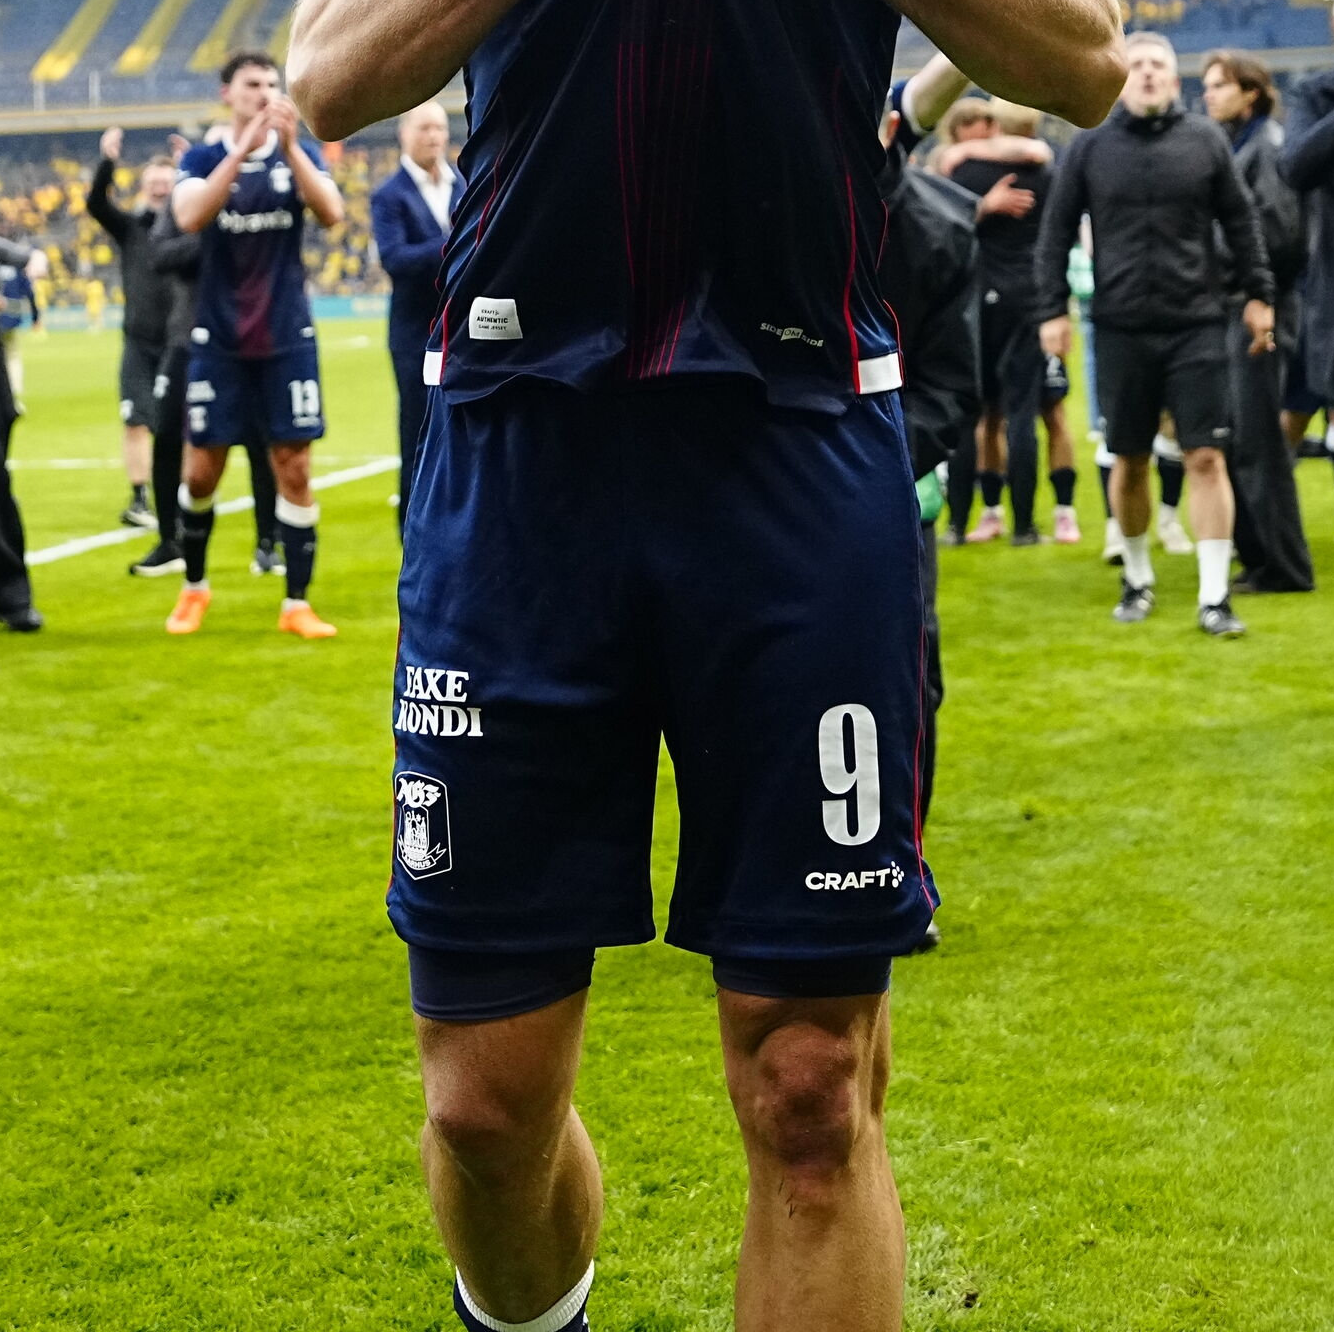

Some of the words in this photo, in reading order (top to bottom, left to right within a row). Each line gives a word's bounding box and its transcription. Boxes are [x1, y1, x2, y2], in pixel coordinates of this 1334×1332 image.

[477, 316, 509, 324] AUTHENTIC
[760, 322, 784, 336] SIDE
[801, 334, 824, 347] SIDE
[403, 665, 470, 703] FAXE
[818, 703, 881, 846] 9
[805, 868, 891, 891] CRAFT
